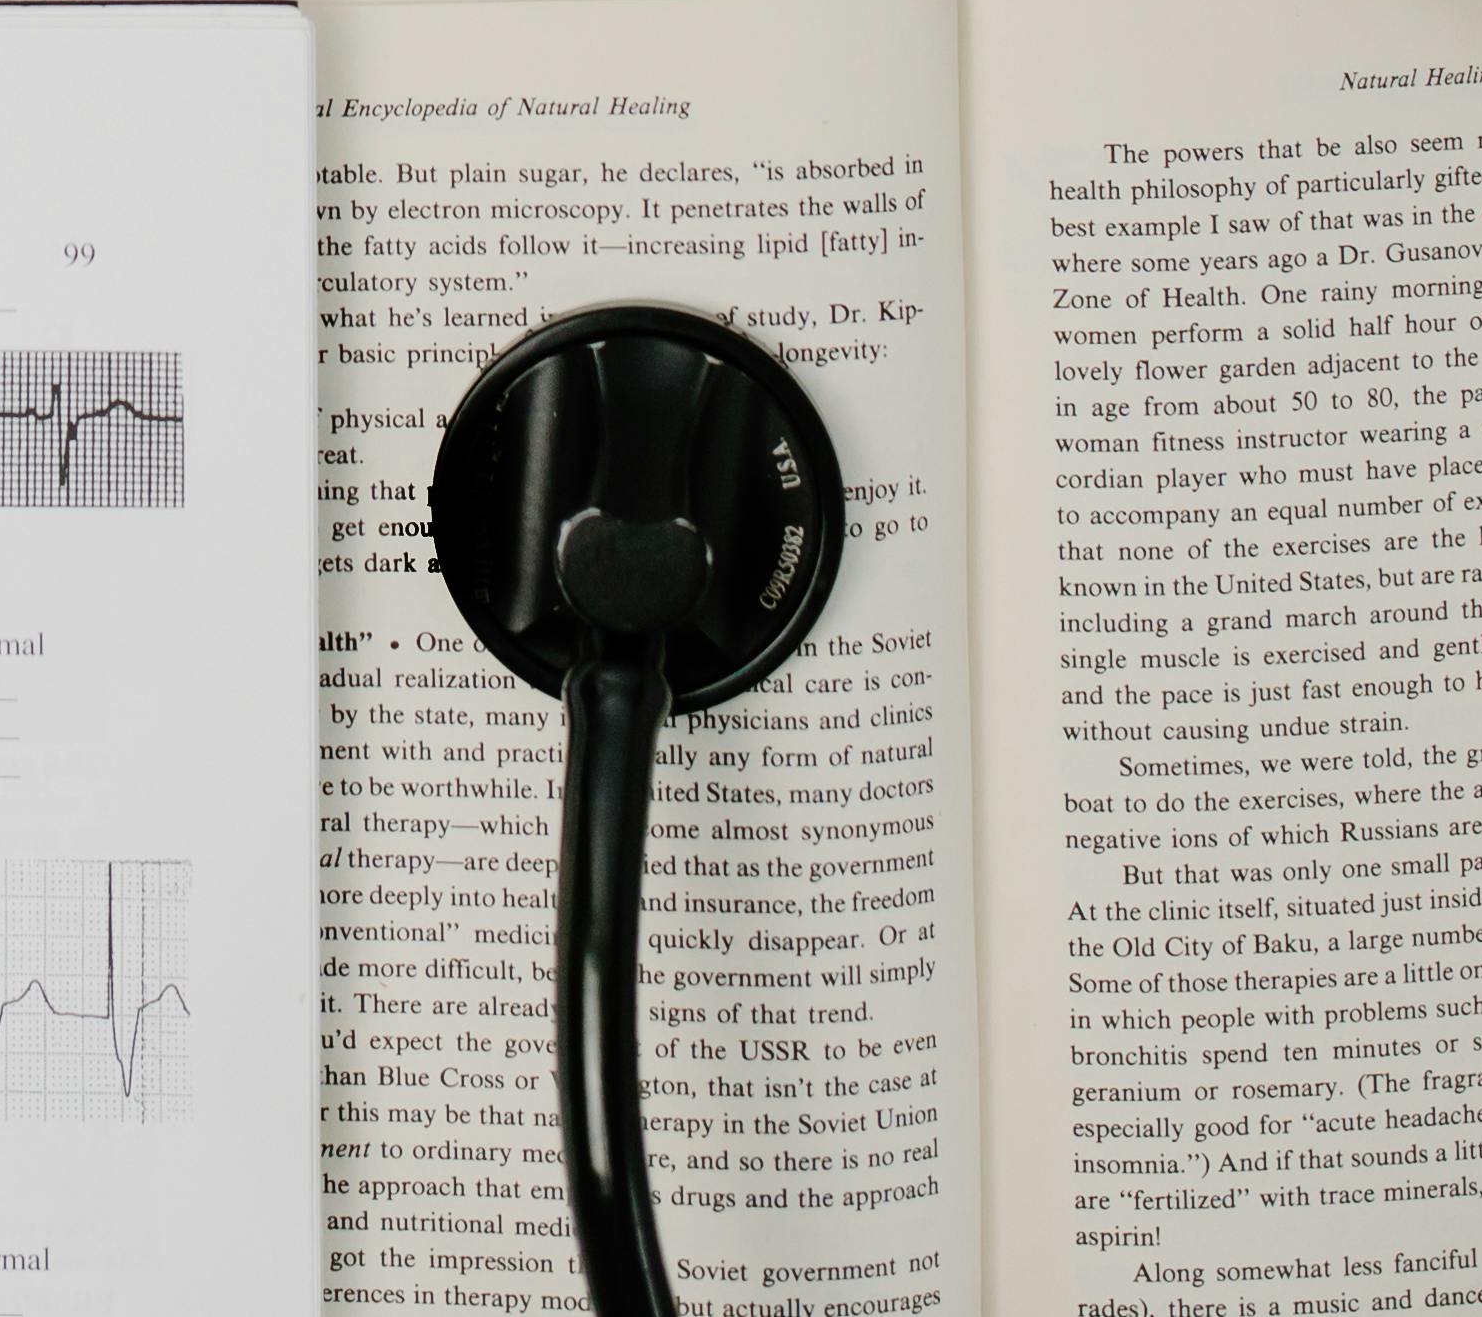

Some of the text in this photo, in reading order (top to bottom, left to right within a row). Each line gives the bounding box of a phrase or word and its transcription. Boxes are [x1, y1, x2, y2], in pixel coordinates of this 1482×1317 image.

[1338, 67, 1418, 92] Natural
[340, 94, 693, 123] Encyclopedia of Natural Healing
[1102, 142, 1151, 165] The
[1162, 145, 1245, 170] powers
[1256, 137, 1304, 161] that
[1315, 135, 1342, 158] be
[1354, 133, 1398, 156] also
[1409, 135, 1465, 154] seem
[395, 161, 439, 184] But
[448, 161, 508, 190] plain
[518, 166, 589, 189] sugar,
[599, 160, 629, 184] he
[638, 160, 740, 187] declares,
[795, 154, 896, 182] absorbed
[904, 152, 925, 176] in
[63, 241, 96, 268] 99
[648, 999, 874, 1029] signs of that trend.
[1075, 1224, 1161, 1253] aspirin!
